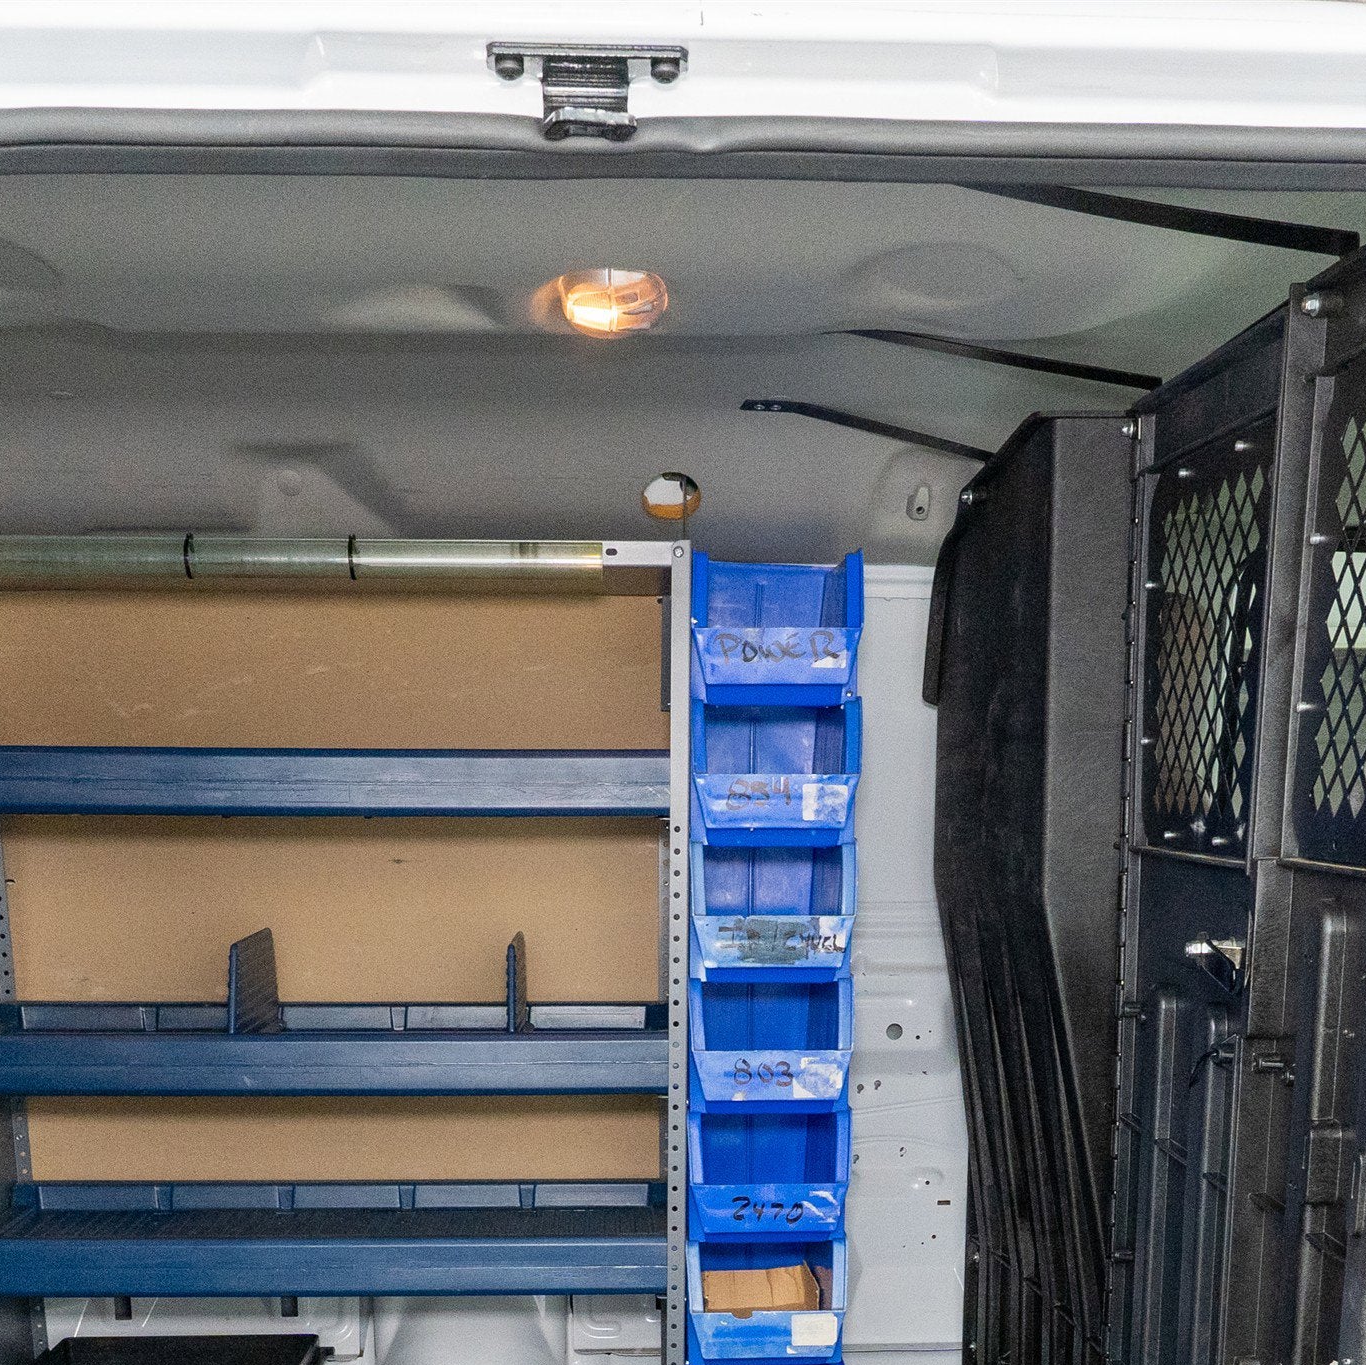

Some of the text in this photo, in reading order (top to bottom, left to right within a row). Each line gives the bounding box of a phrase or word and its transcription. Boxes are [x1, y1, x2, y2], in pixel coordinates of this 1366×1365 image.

[714, 630, 840, 664] POWER
[733, 1058, 793, 1087] 803
[731, 1195, 804, 1224] 2470
